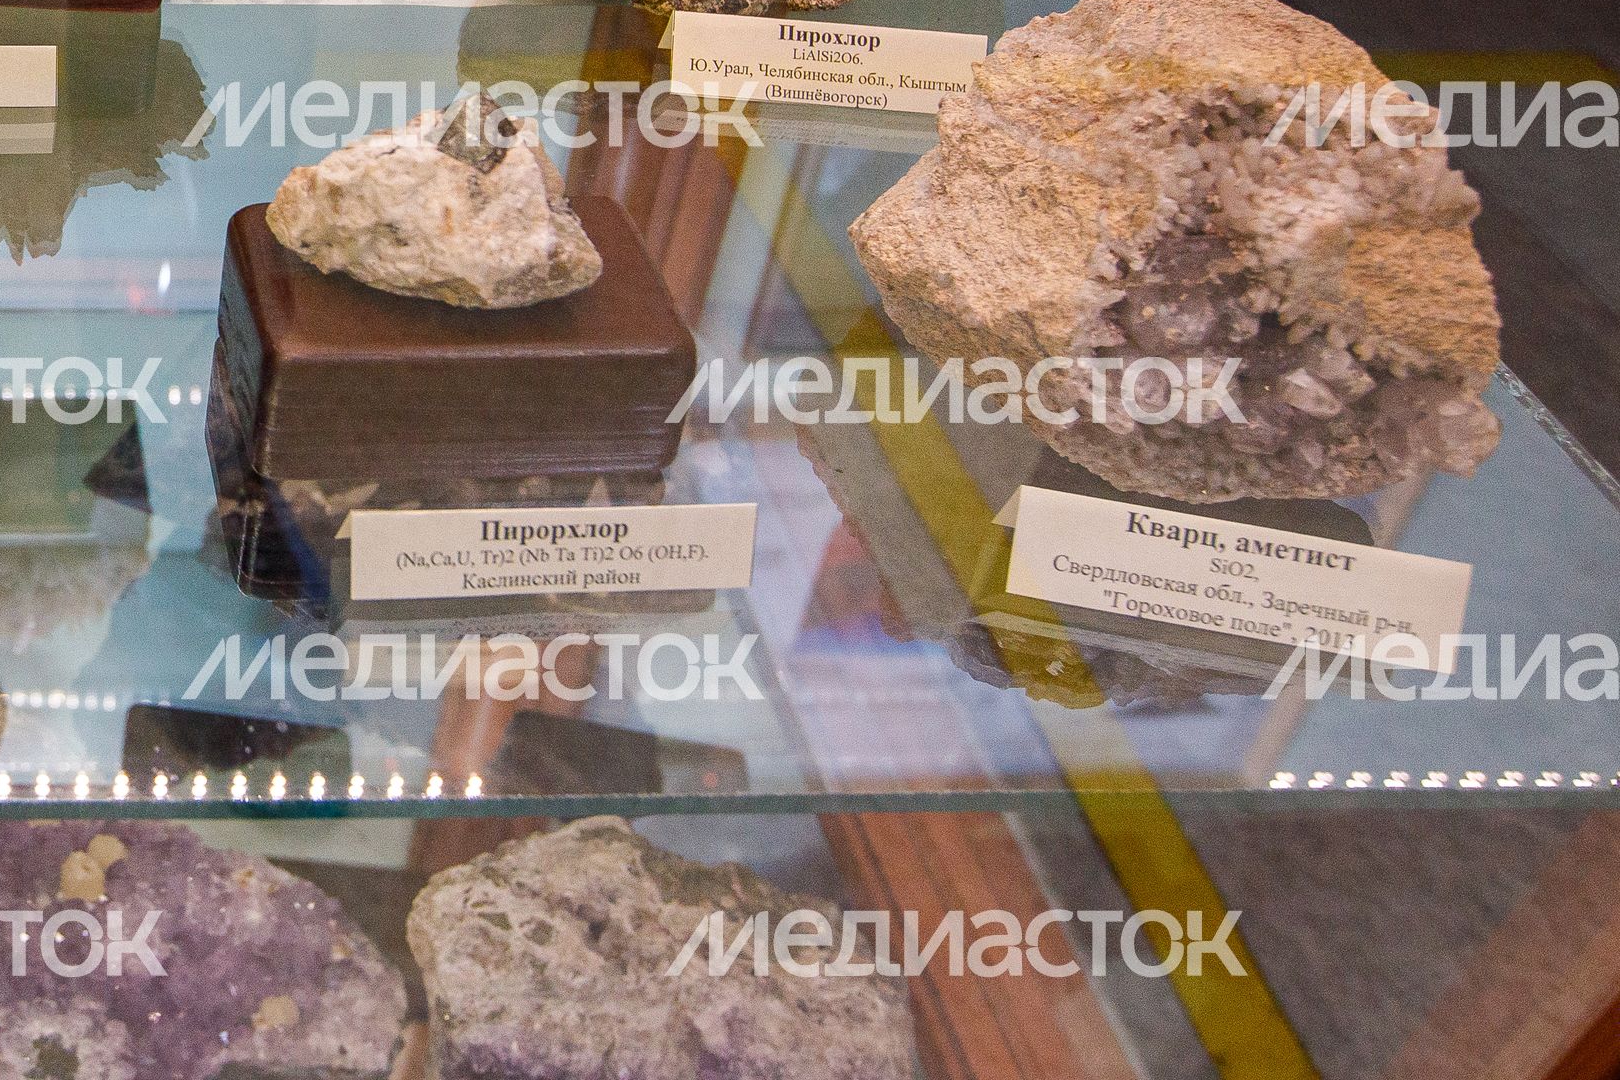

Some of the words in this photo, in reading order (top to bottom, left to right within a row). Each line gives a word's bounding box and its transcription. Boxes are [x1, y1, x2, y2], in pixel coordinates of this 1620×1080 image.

[778, 24, 881, 51] Пирохлор
[793, 48, 863, 65] LiAlSi2O6.
[759, 64, 853, 84] Челябинская
[858, 73, 894, 89] обл.,
[899, 75, 967, 93] Кыштым
[765, 85, 888, 109] (Вишнёвогорск)
[480, 520, 629, 544] Пирорхлор
[1125, 512, 1226, 552] Кварц,
[1235, 536, 1356, 571] аметист
[519, 548, 549, 566] (Nb
[555, 548, 575, 562] Ta
[582, 545, 614, 563] Ti)2
[462, 569, 577, 590] Каслинский
[583, 571, 640, 589] район
[1210, 558, 1260, 581] SiO2,
[1052, 554, 1198, 597] Свердловская
[1204, 584, 1255, 607] обл.,
[1261, 591, 1369, 627] Заречный
[1103, 590, 1224, 628] "Гороховое
